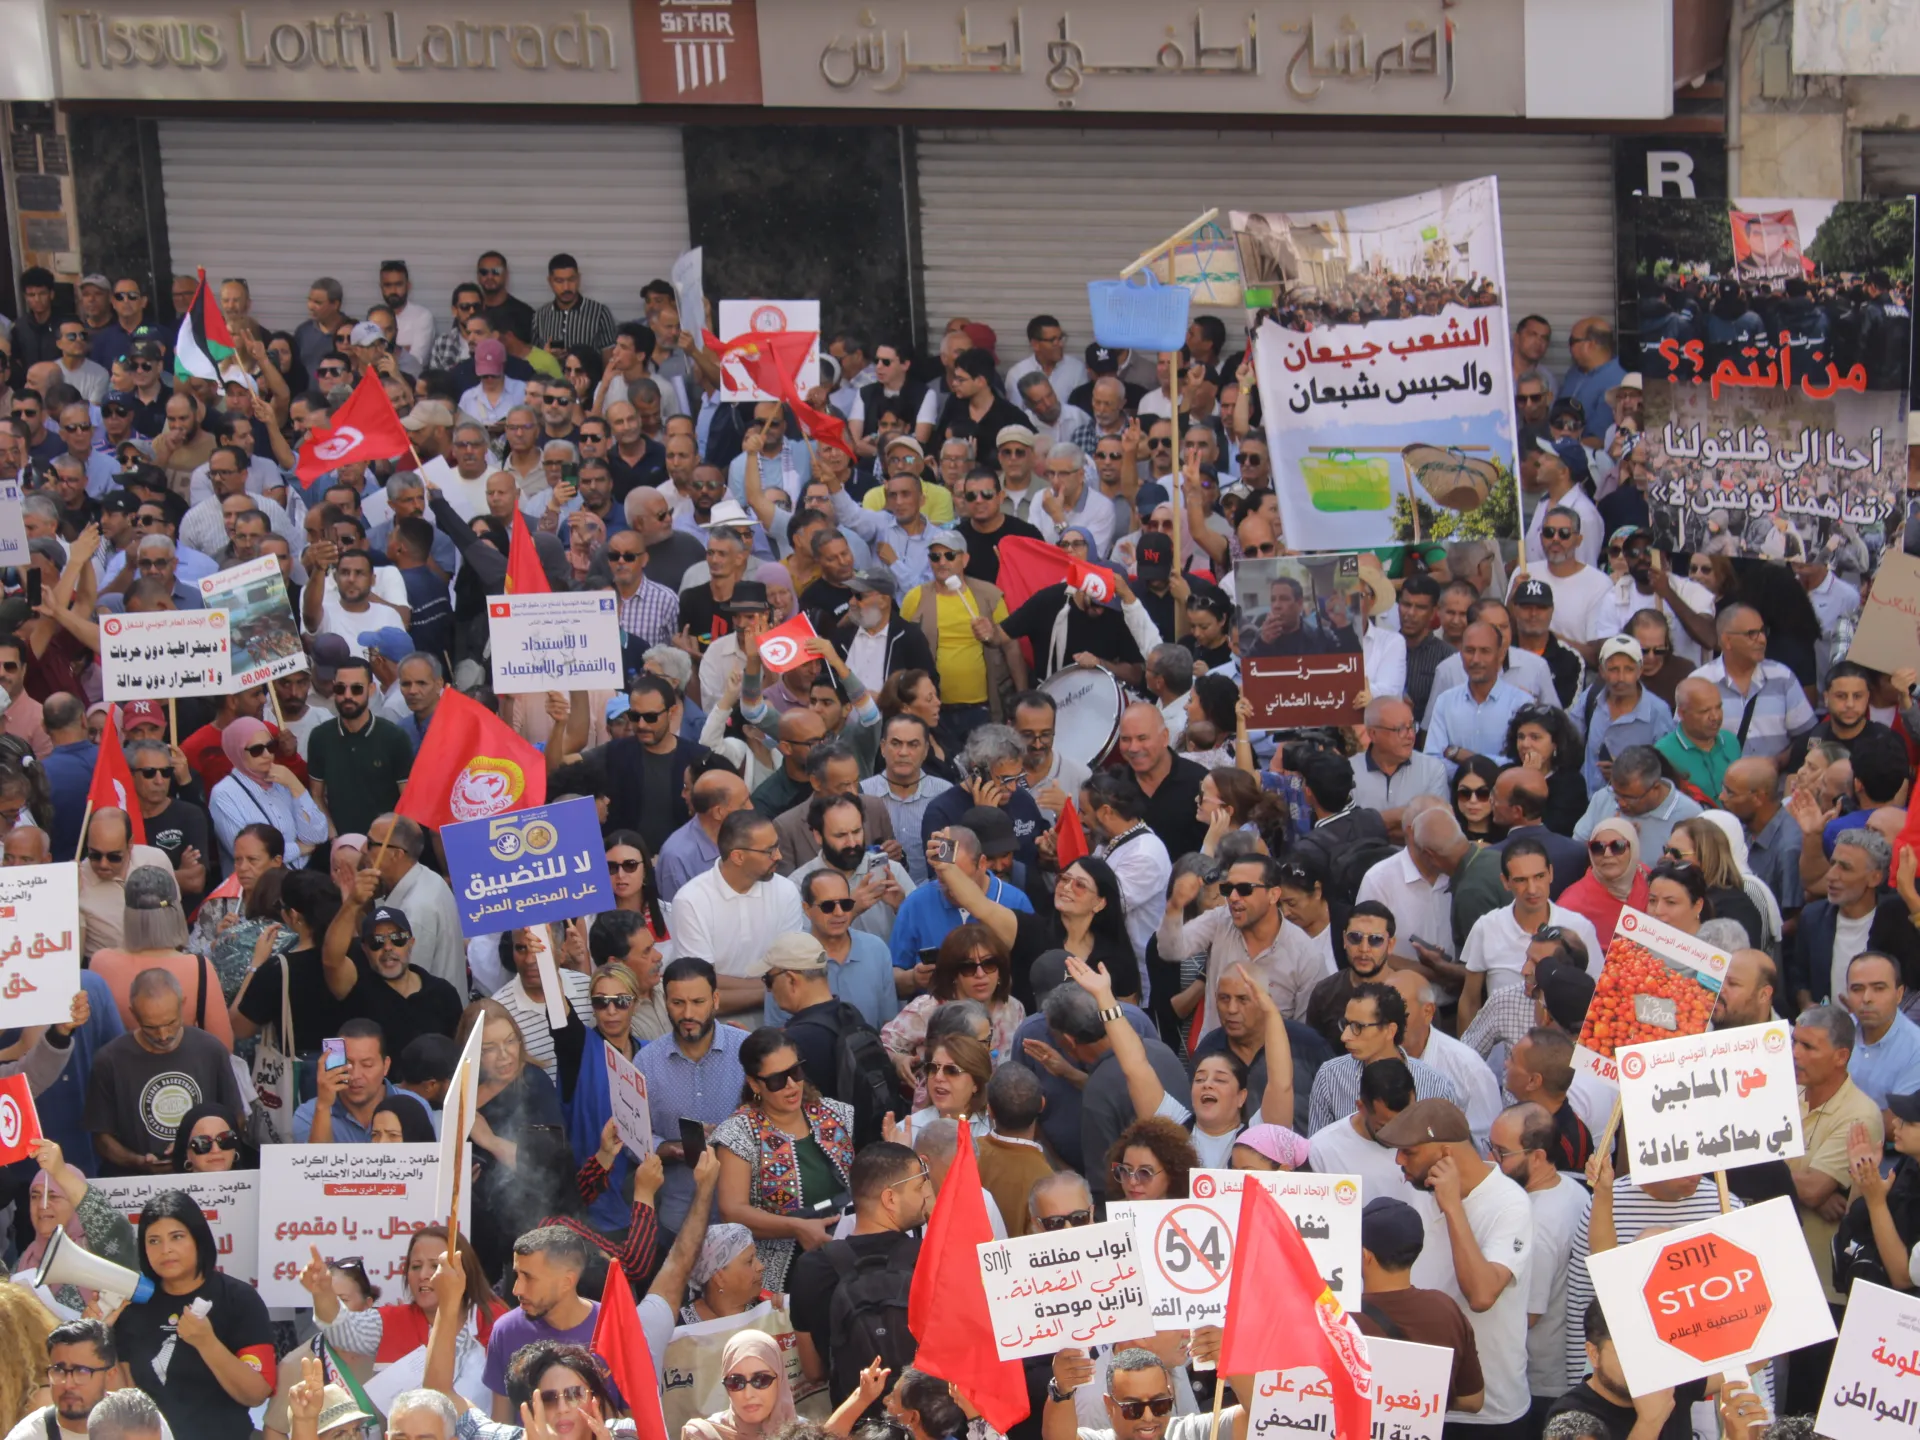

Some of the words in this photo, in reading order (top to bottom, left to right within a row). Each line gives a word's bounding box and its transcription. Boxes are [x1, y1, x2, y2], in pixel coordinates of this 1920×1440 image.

[60, 9, 223, 70] Tissus
[237, 9, 380, 70] Lotfi
[387, 10, 617, 72] Latrach
[1046, 8, 1259, 108] لطفي
[1388, 316, 1489, 361] الشعب
[1283, 337, 1382, 372] جيعان
[1385, 360, 1493, 404] والحبس
[1801, 352, 1867, 398] من
[1290, 371, 1380, 413] شبعان
[1825, 427, 1882, 474] أحنا
[1691, 481, 1775, 518] تونس
[110, 645, 141, 662] حريات
[145, 643, 163, 660] دون
[220, 638, 227, 652] لا
[208, 668, 214, 682] لا
[569, 657, 615, 676] والتفقير
[117, 673, 142, 687] عدالة
[146, 674, 165, 689] دون
[1265, 692, 1311, 715] العثماني
[1313, 691, 1345, 709] لرشيد
[489, 816, 557, 861] 50
[574, 851, 591, 872] لا
[465, 856, 566, 900] للتضييق
[516, 888, 568, 912] المجتمع
[572, 884, 597, 900] على
[469, 899, 512, 922] المدني
[27, 931, 72, 959] الحق
[3, 973, 37, 999] حق
[1710, 1044, 1732, 1058] العام
[1734, 1037, 1758, 1053] الإتحاد
[1650, 1052, 1675, 1069] للشغل
[1678, 1047, 1708, 1068] التونسي
[1591, 1057, 1618, 1083] 4,80
[1652, 1068, 1728, 1113] المساجين
[1735, 1067, 1767, 1098] حق
[1696, 1124, 1760, 1157] محاكمة
[1766, 1116, 1792, 1156] في
[330, 1153, 348, 1166] أجل
[350, 1156, 364, 1166] من
[367, 1155, 395, 1166] مقاومة
[410, 1154, 439, 1166] مقاومة
[1638, 1134, 1689, 1166] عادلة
[292, 1156, 328, 1169] الكرامة
[352, 1168, 386, 1180] والعدالة
[304, 1169, 349, 1180] الاجتماعية
[133, 1185, 152, 1198] أجل
[379, 1186, 396, 1195] تونس
[1220, 1182, 1244, 1195] لشغل
[1280, 1185, 1301, 1196] العام
[1304, 1186, 1330, 1199] الإتحاد
[275, 1217, 336, 1240] مقموع
[343, 1217, 357, 1240] يا
[1030, 1249, 1081, 1268] مغلقة
[1086, 1232, 1132, 1262] أبواب
[1166, 1226, 1225, 1273] 54
[1666, 1241, 1718, 1271] snjt
[984, 1243, 1013, 1275] snjt
[1098, 1286, 1143, 1311] زنازين
[1658, 1268, 1753, 1315] STOP
[1034, 1298, 1092, 1318] موصدة
[1000, 1318, 1064, 1348] العقول
[1072, 1311, 1117, 1341] على
[1260, 1372, 1294, 1397] على
[1377, 1386, 1439, 1418] ارفعوا
[1834, 1381, 1918, 1426] المواطن
[1255, 1408, 1326, 1437] الصحفي
